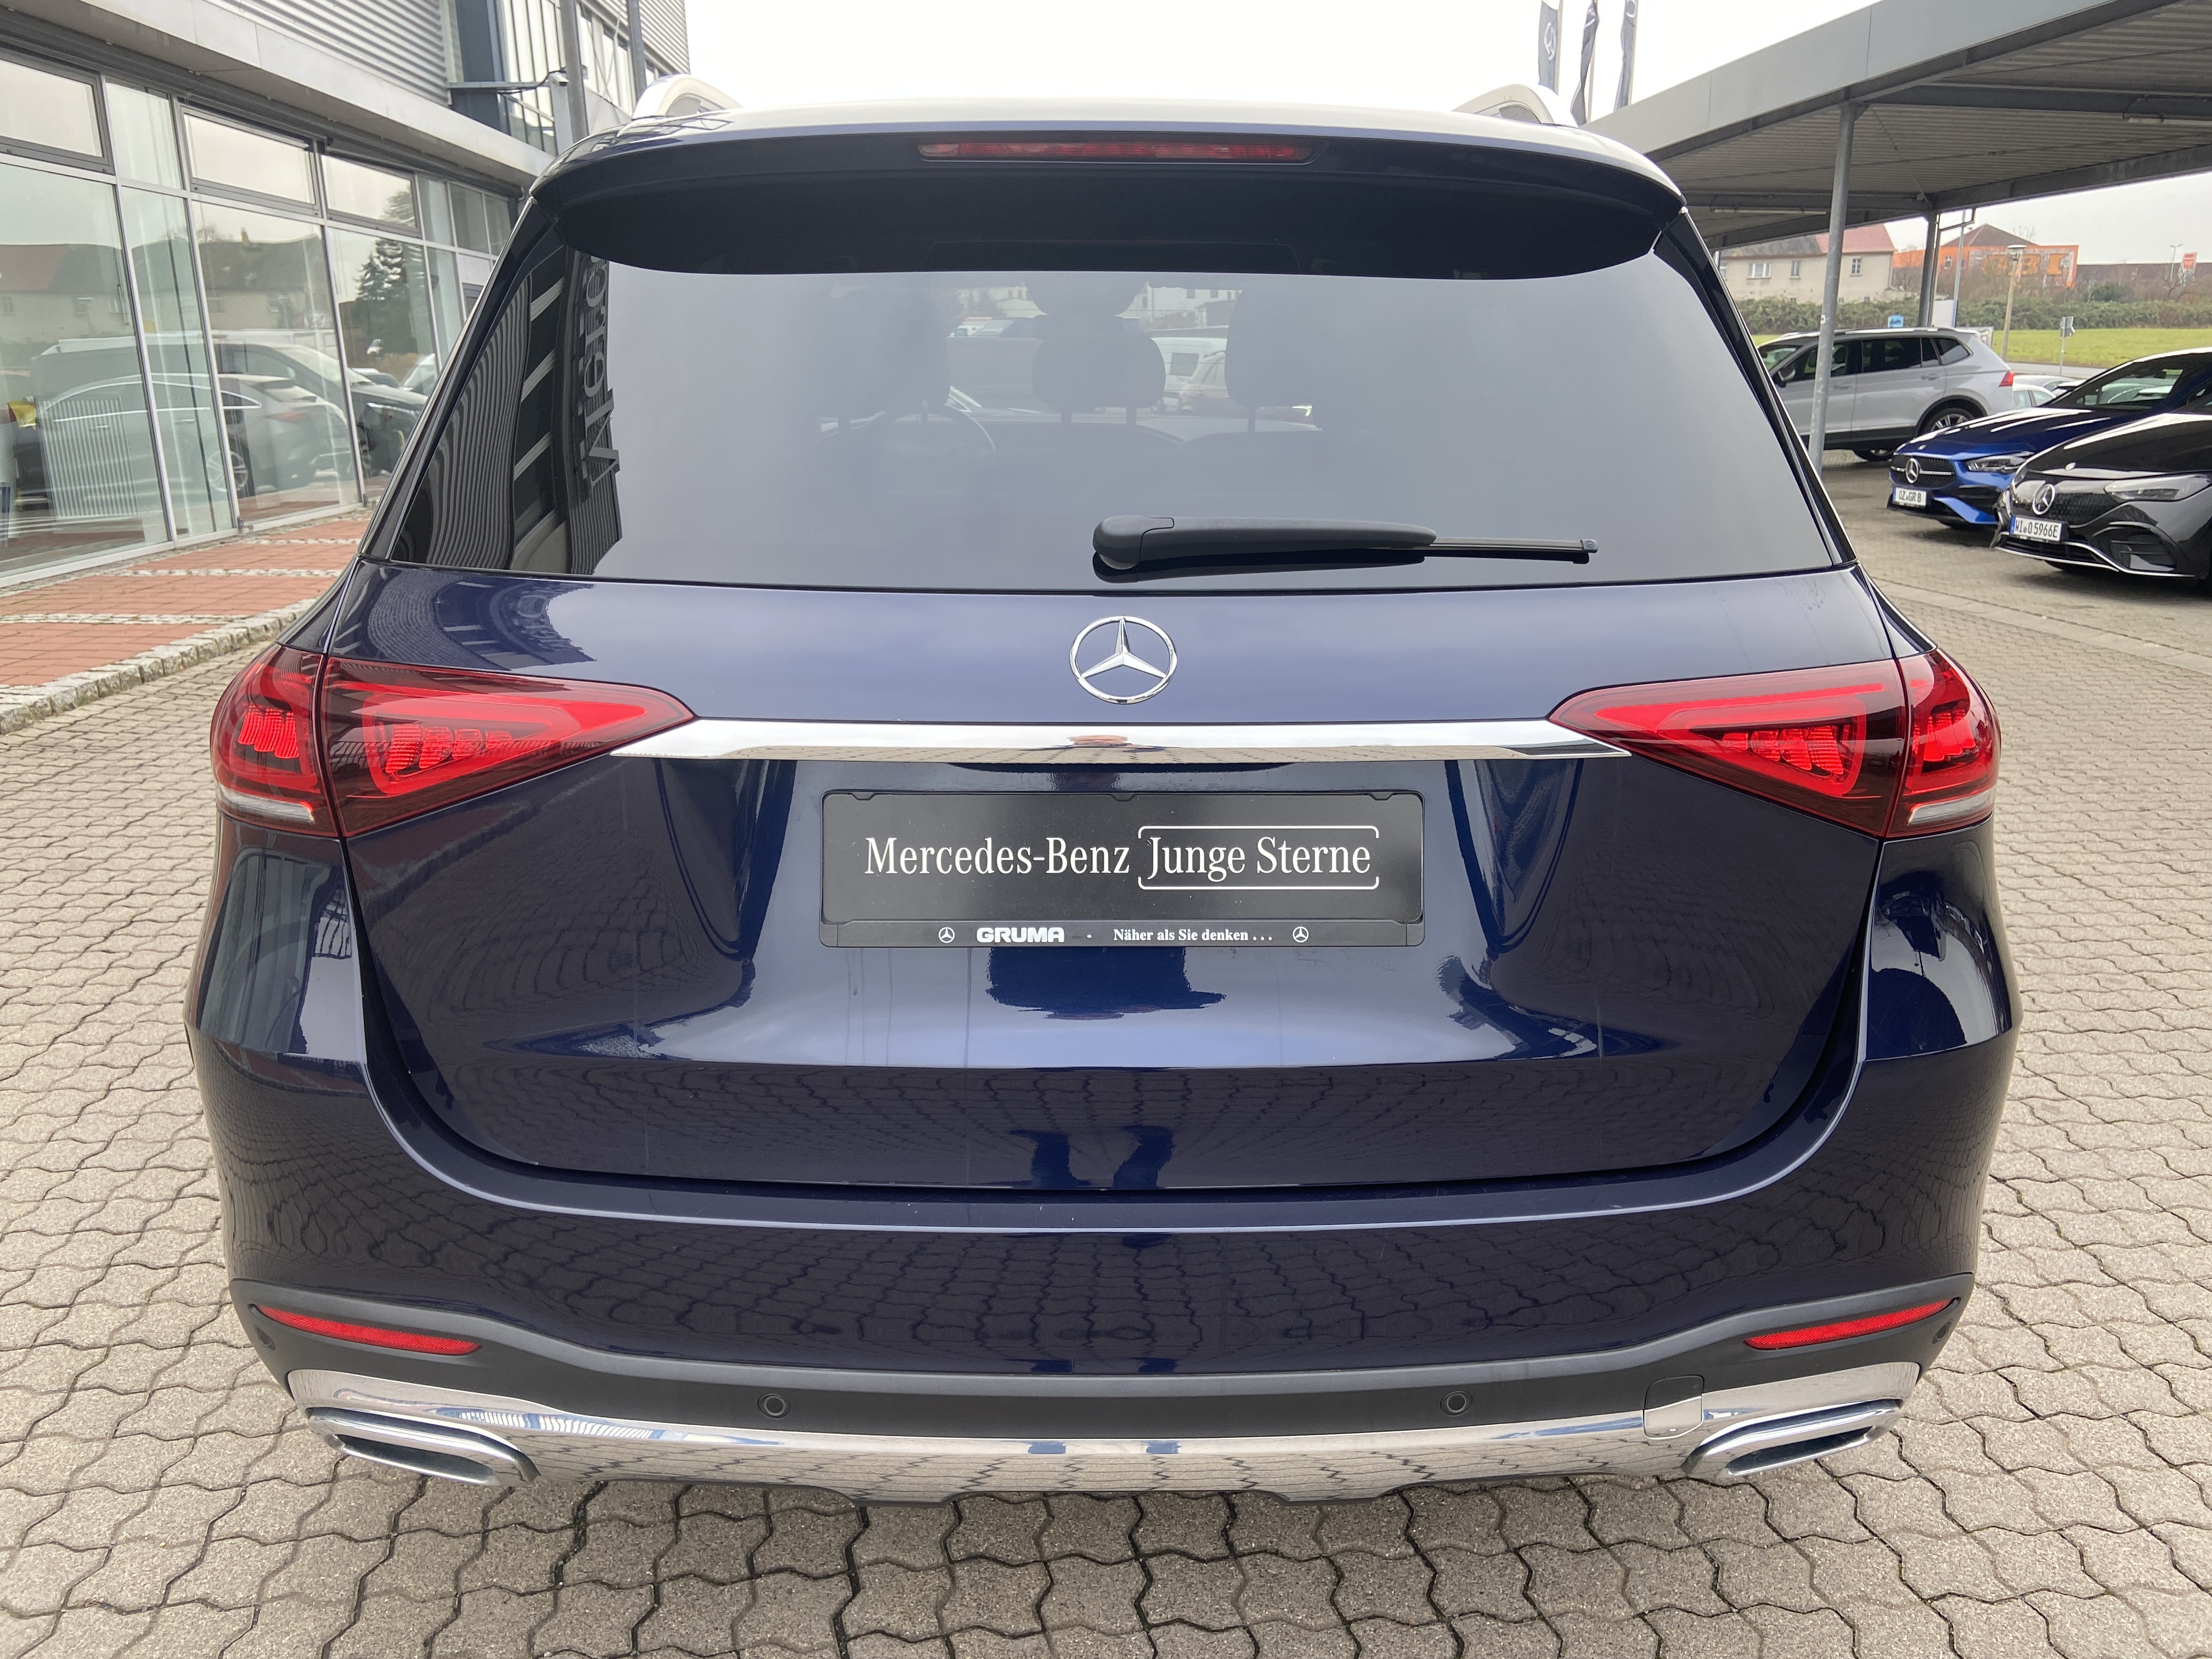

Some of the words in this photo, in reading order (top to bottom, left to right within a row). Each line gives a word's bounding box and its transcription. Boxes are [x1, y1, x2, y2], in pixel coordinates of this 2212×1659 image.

[2034, 522, 2058, 538] 5966E
[864, 837, 1130, 874] Mercedes-Benz
[1146, 837, 1246, 883] Junge
[1256, 836, 1372, 874] Sterne
[976, 927, 1065, 943] GRUMA
[1113, 928, 1154, 941] Näher
[1156, 929, 1175, 941] als
[1178, 928, 1198, 941] Sie
[1201, 928, 1249, 941] denken
